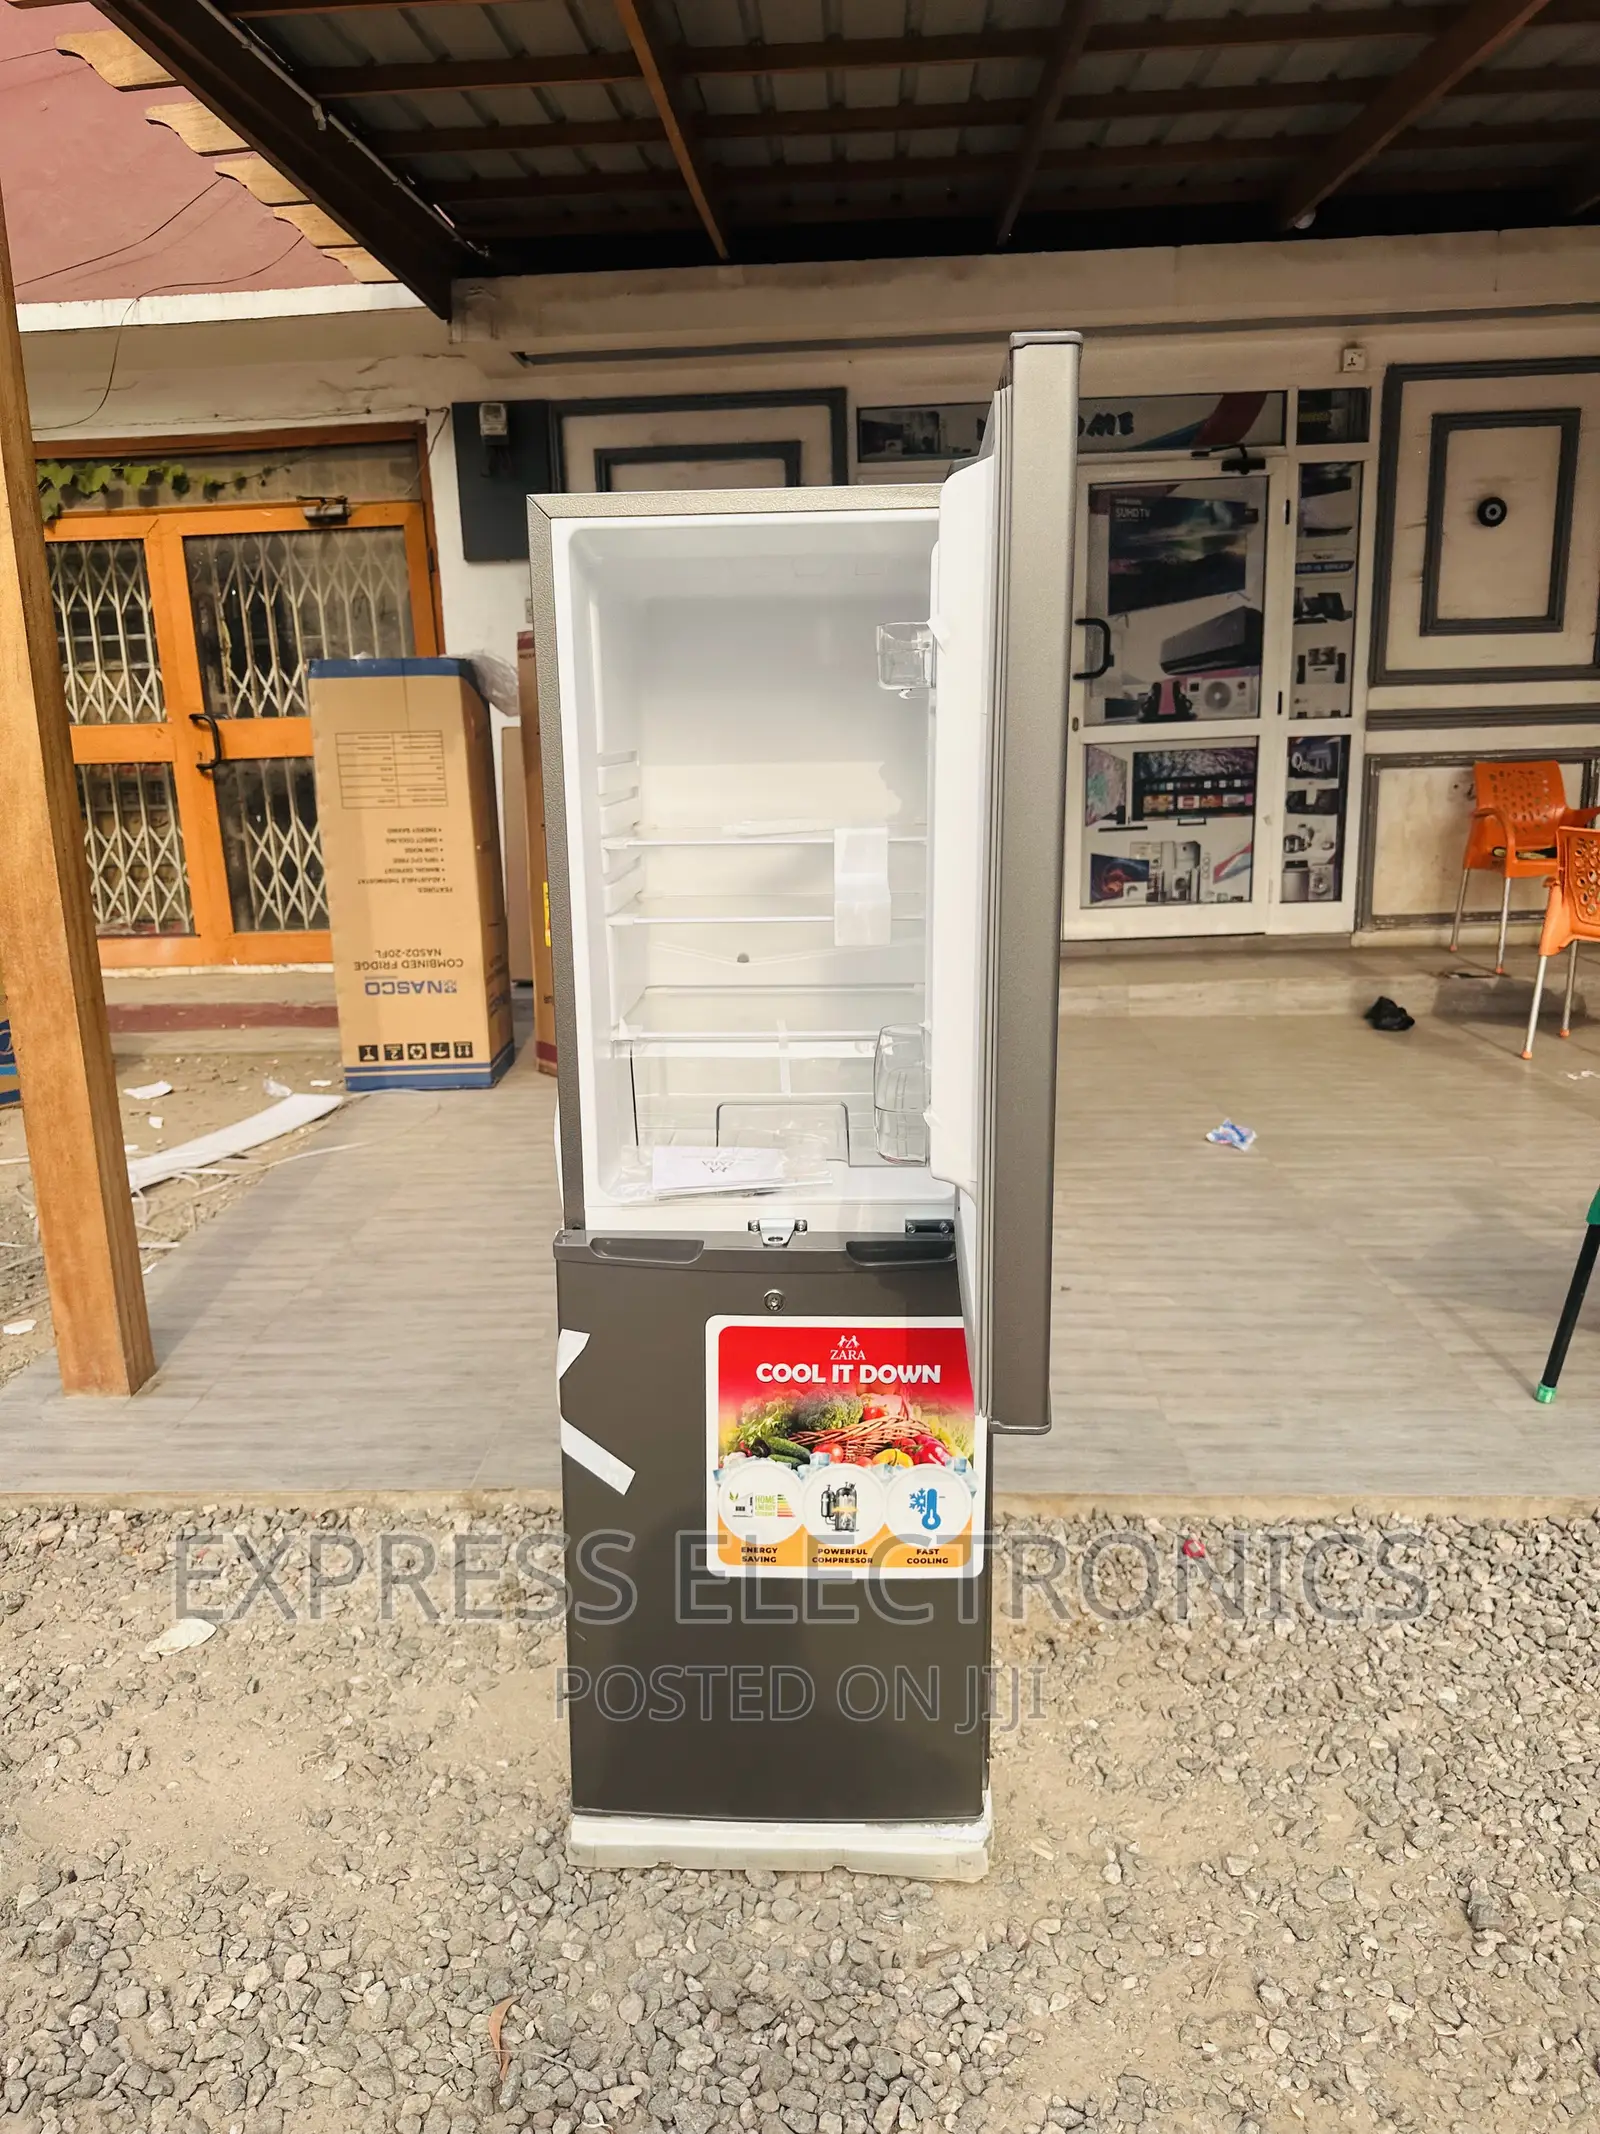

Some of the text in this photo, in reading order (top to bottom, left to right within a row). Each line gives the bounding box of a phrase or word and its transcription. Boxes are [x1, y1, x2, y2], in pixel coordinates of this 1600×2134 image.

[375, 948, 442, 958] NASD2-20FL
[354, 958, 464, 971] COMBINED FRIDGE
[364, 980, 443, 996] NASCO
[830, 1349, 866, 1361] ZARA
[755, 1363, 941, 1384] COOL IT DOWN
[755, 1494, 776, 1503] HOME
[740, 1546, 778, 1554] ENERGY
[906, 1557, 949, 1565] COOLING
